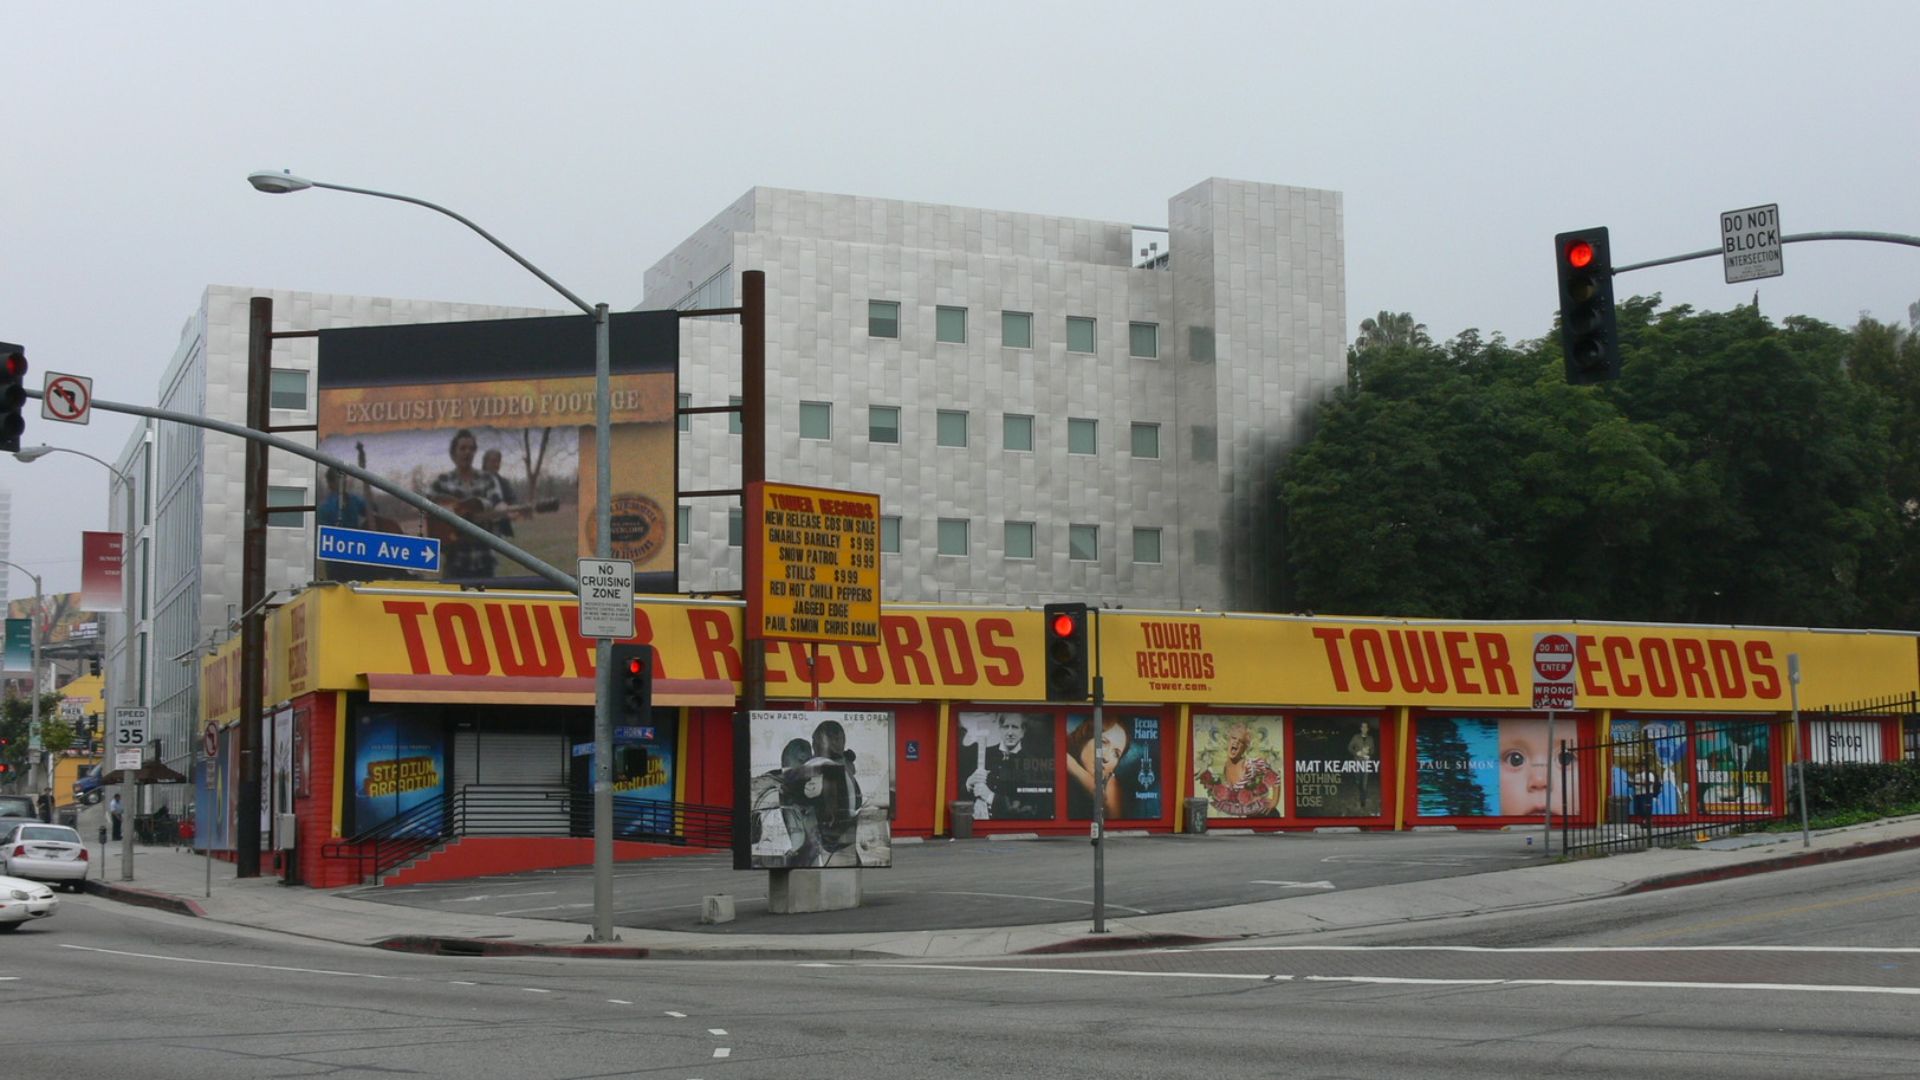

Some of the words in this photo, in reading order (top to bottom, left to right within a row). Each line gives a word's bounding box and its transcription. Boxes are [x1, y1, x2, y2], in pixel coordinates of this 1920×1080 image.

[1724, 215, 1742, 232] DO
[1747, 209, 1775, 229] NOT
[1726, 230, 1777, 253] BLOCK
[1727, 250, 1779, 267] INTERSECTION
[346, 398, 462, 423] EXCLUSIVE
[469, 394, 534, 417] VIDEO
[541, 390, 639, 414] FOOTGE
[768, 492, 815, 513] TOWER
[818, 498, 874, 519] RECORDS
[765, 511, 784, 525] NEW
[786, 513, 821, 529] RELEASE
[843, 518, 854, 533] ON
[856, 519, 875, 535] SALE
[769, 528, 801, 545] GNARLS
[804, 531, 841, 549] BARKLEY
[322, 535, 366, 556] Horn
[377, 541, 411, 560] Ave
[779, 547, 804, 562] SNOW
[807, 550, 839, 566] PATROL
[598, 564, 614, 576] NO
[785, 565, 816, 581] STILLS
[581, 576, 631, 588] CRUISING
[592, 588, 621, 599] ZONE
[770, 581, 786, 596] RED
[789, 583, 805, 597] HOT
[809, 584, 833, 600] CHILI
[837, 587, 872, 602] PEPPERS
[793, 601, 825, 616] JAGGED
[828, 603, 849, 618] EDGE
[765, 616, 787, 631] PAUL
[790, 618, 819, 633] SIMON
[824, 620, 849, 635] CHRIS
[851, 622, 877, 637] ISAAK
[1141, 622, 1202, 650] TOWER
[1540, 643, 1550, 652] DO
[1554, 643, 1569, 652] NOT
[1136, 651, 1216, 679] RECORDS
[1312, 627, 1520, 695] TOWER
[1575, 635, 1782, 699] ECORDS
[1541, 664, 1567, 672] ENTER
[1535, 686, 1573, 694] WRONG
[118, 710, 145, 718] SPEED
[119, 729, 143, 743] 35
[1296, 760, 1321, 773] MAT
[1324, 760, 1380, 773] KEARNEY
[1420, 760, 1450, 770] PAUL
[1456, 760, 1494, 770] SIMON
[1296, 773, 1342, 784] NOTHING
[1296, 785, 1321, 796] LEFT
[1324, 785, 1338, 796] TO
[1296, 796, 1323, 808] LOSE
